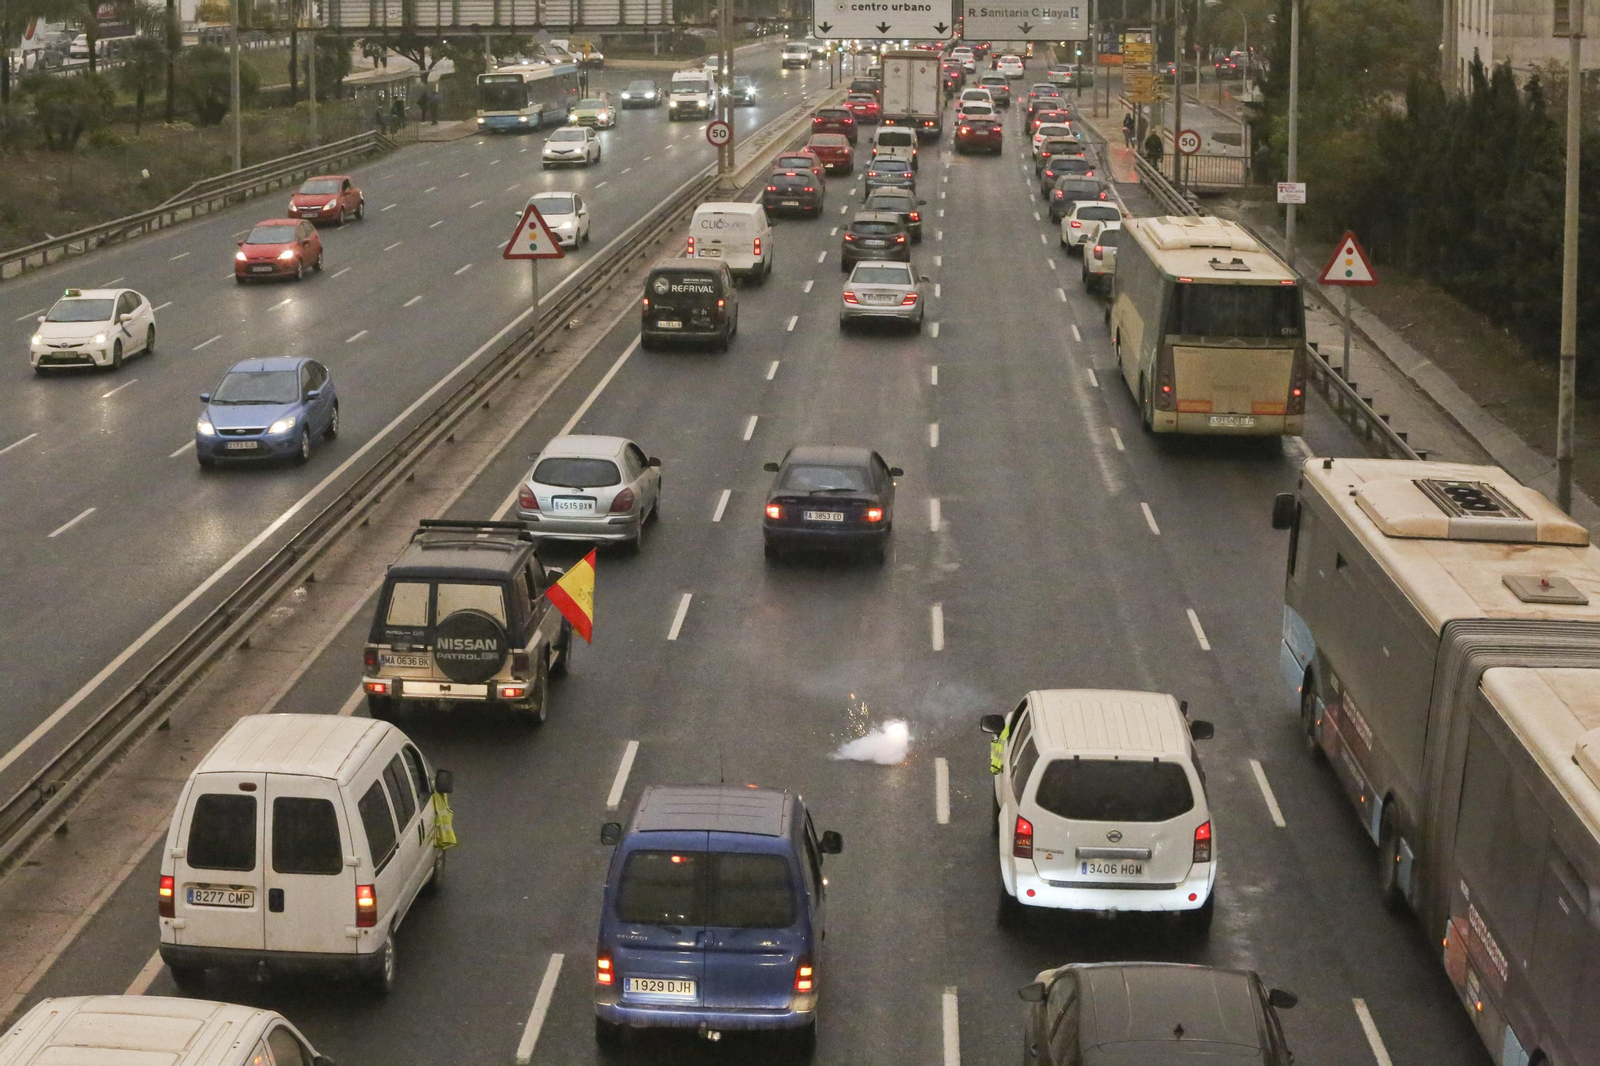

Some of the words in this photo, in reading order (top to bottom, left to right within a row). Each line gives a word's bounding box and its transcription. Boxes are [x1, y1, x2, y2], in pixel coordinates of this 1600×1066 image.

[851, 2, 888, 11] centro
[892, 3, 932, 11] urbano
[968, 8, 978, 17] R.
[980, 8, 1029, 17] Sanitaria
[1031, 8, 1040, 17] C.
[1042, 8, 1069, 19] Haya
[712, 129, 727, 138] 50
[1182, 138, 1196, 147] 50
[671, 284, 714, 293] REFRIVAL
[559, 502, 577, 510] 4515
[814, 512, 831, 520] 3853
[437, 638, 498, 651] NISSAN
[385, 655, 395, 664] MA
[396, 656, 418, 666] 0636
[418, 657, 429, 666] BK
[1089, 863, 1118, 875] 3406
[1120, 864, 1143, 875] HGM
[195, 890, 224, 902] 8277
[228, 892, 250, 904] CMP
[634, 979, 664, 992] 1929
[667, 981, 691, 993] DJH
